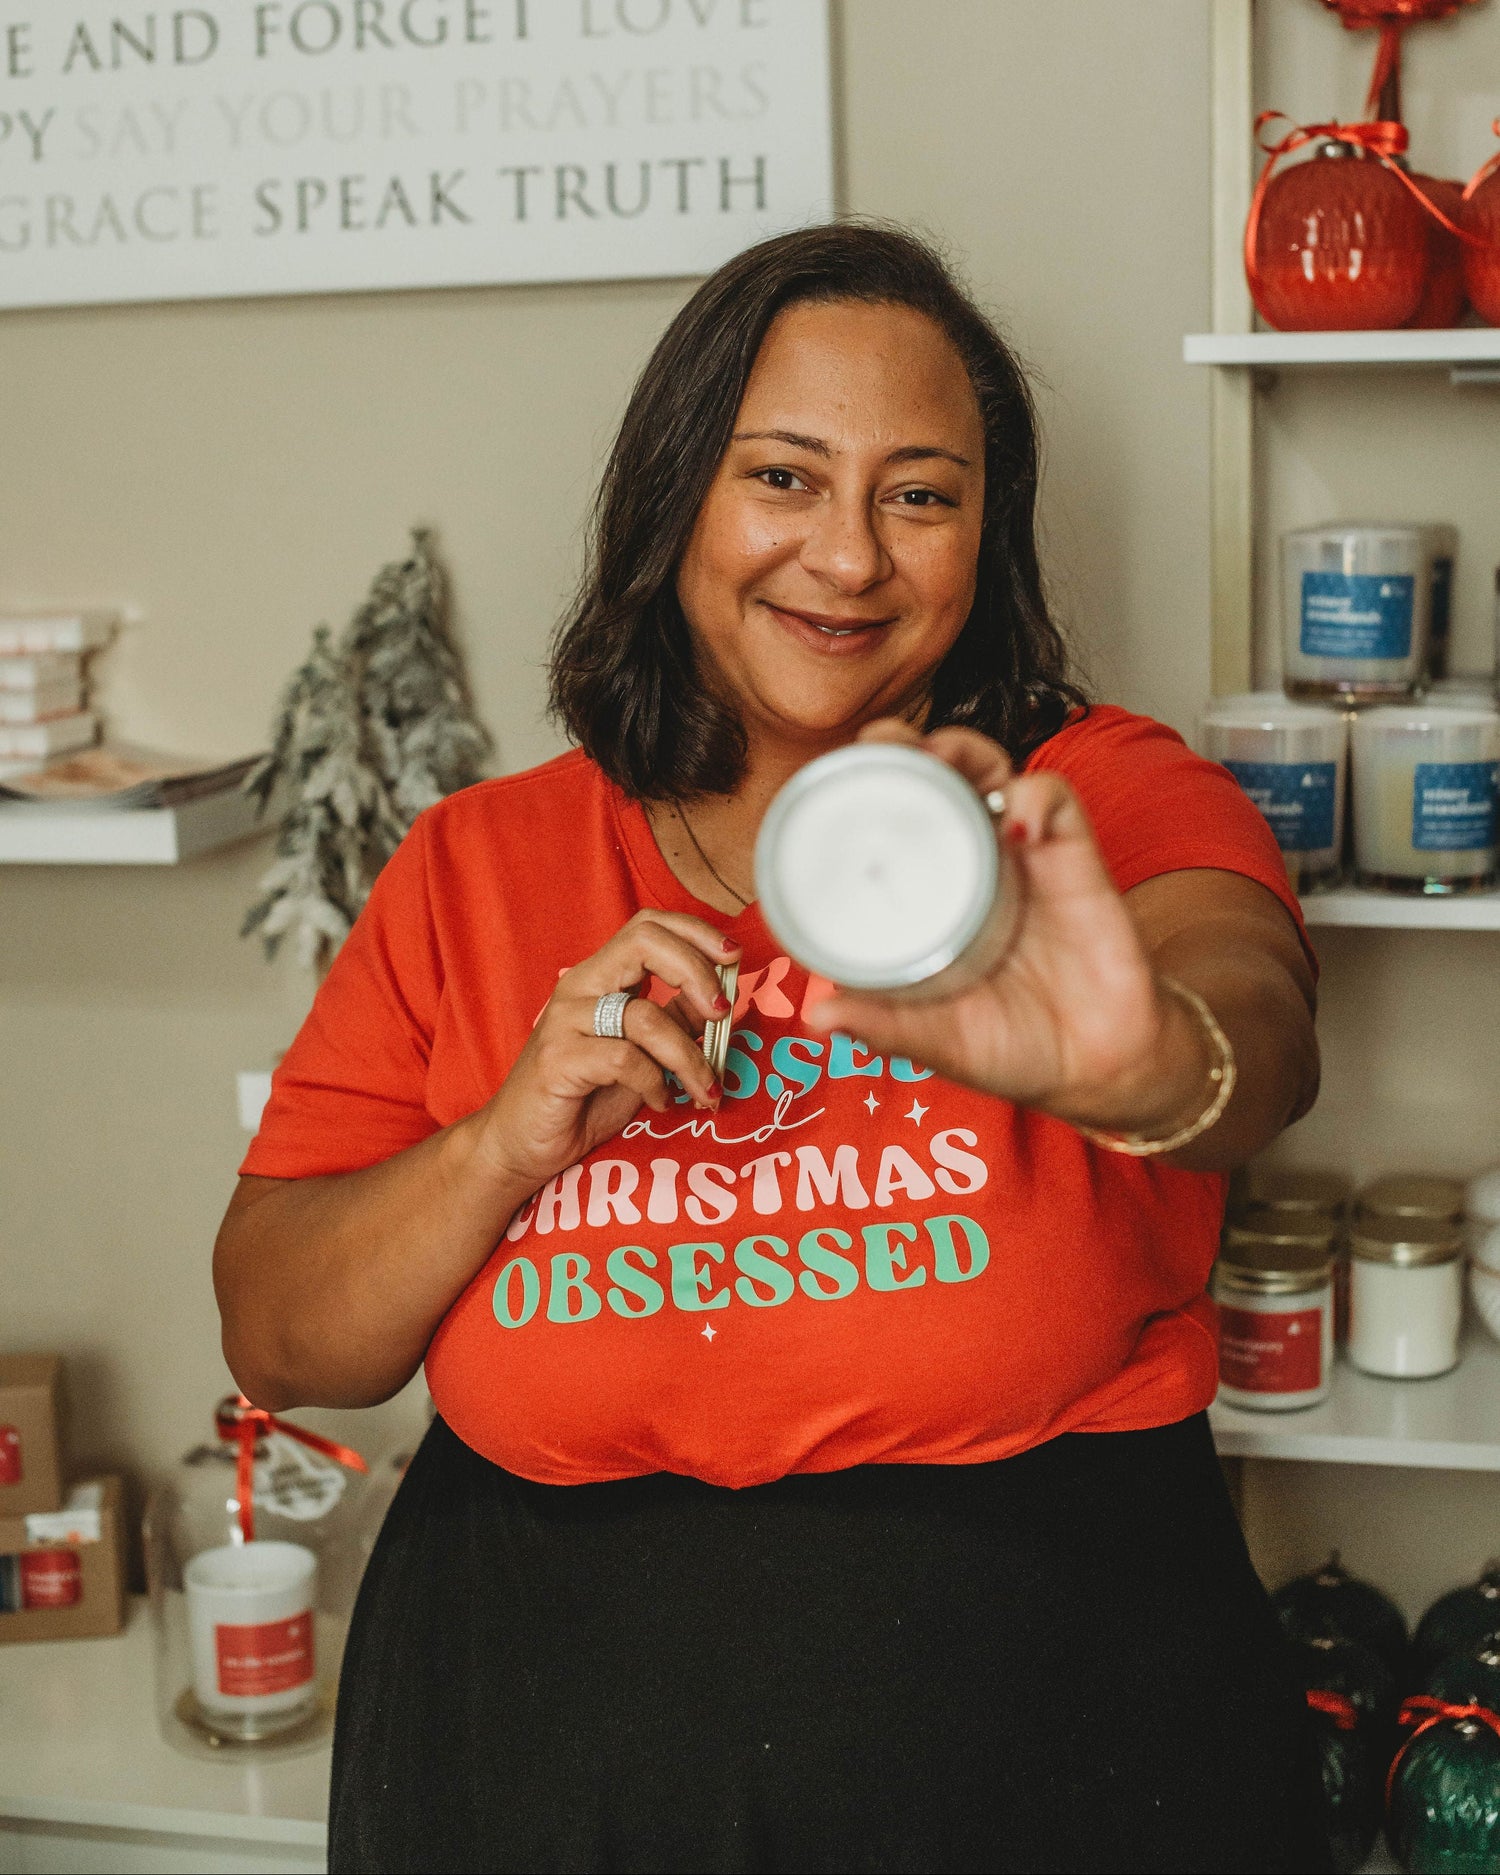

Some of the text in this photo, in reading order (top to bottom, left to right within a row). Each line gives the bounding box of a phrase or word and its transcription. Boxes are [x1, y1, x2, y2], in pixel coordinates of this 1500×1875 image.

[61, 8, 220, 74] AND
[253, 0, 532, 57] FORGET
[580, 0, 769, 40] LOVE
[75, 99, 189, 158] SAY
[212, 82, 424, 149] YOUR
[454, 60, 770, 135] PRAYERS
[253, 168, 473, 236] SPEAK
[496, 155, 766, 222] TRUTH
[621, 1089, 826, 1144] and
[492, 1214, 991, 1329] OBSESSED
